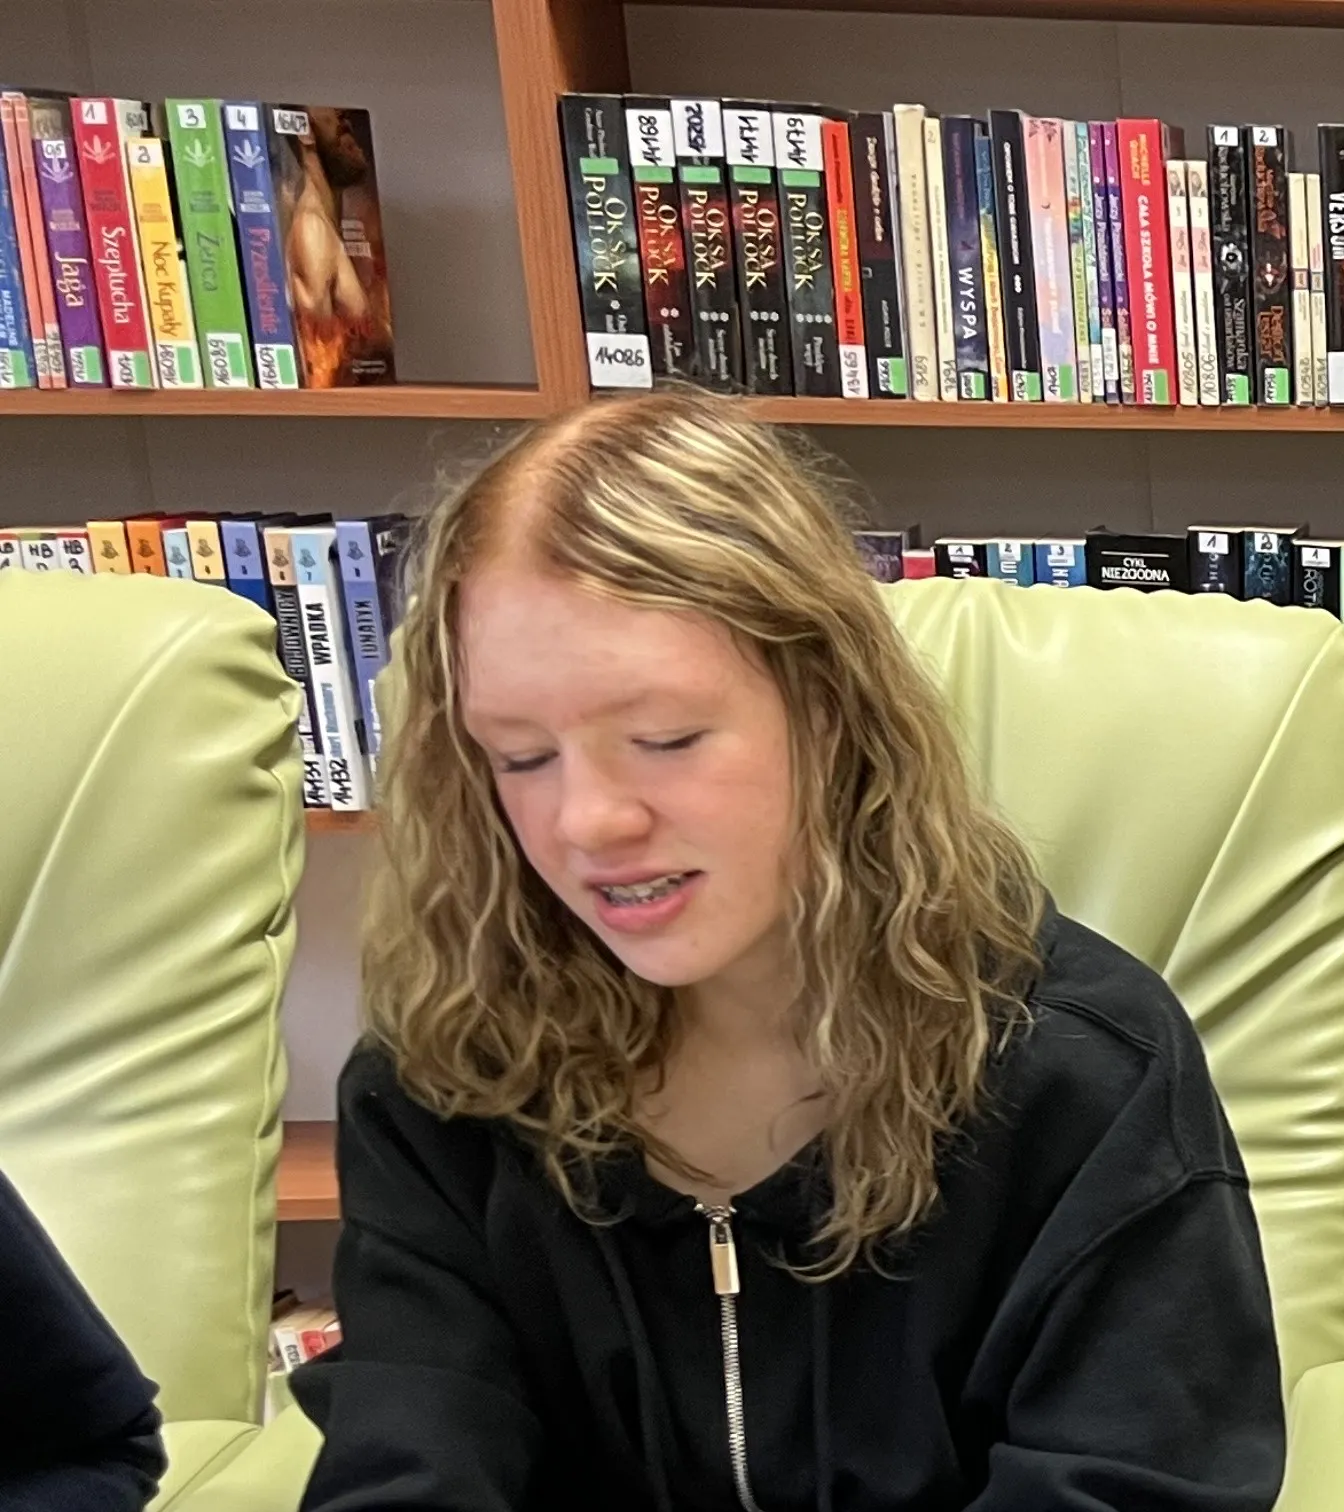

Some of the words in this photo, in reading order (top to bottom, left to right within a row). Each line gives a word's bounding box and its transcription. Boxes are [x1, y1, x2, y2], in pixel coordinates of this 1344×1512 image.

[84, 104, 97, 121] 1
[186, 108, 200, 126] 3
[236, 108, 248, 125] 4
[1220, 130, 1229, 143] 1
[1258, 129, 1270, 142] 2
[583, 176, 618, 293] POLLOCK
[640, 186, 669, 286] POLLOCK
[688, 189, 716, 290] POLLOCK
[738, 189, 767, 291] POLLOCK
[787, 193, 815, 290] POLLOCK
[100, 226, 133, 324] Szeptucha
[152, 241, 171, 280] Noc
[54, 253, 87, 308] Jaga
[957, 266, 978, 340] WYSPA
[595, 348, 645, 367] 14086
[29, 542, 53, 558] HB
[63, 539, 84, 554] HB
[1206, 535, 1218, 549] 1
[1100, 567, 1170, 582] NIEZGODNA
[1122, 557, 1146, 568] CYKL
[306, 602, 333, 666] WPADKA
[331, 759, 351, 804] 14132
